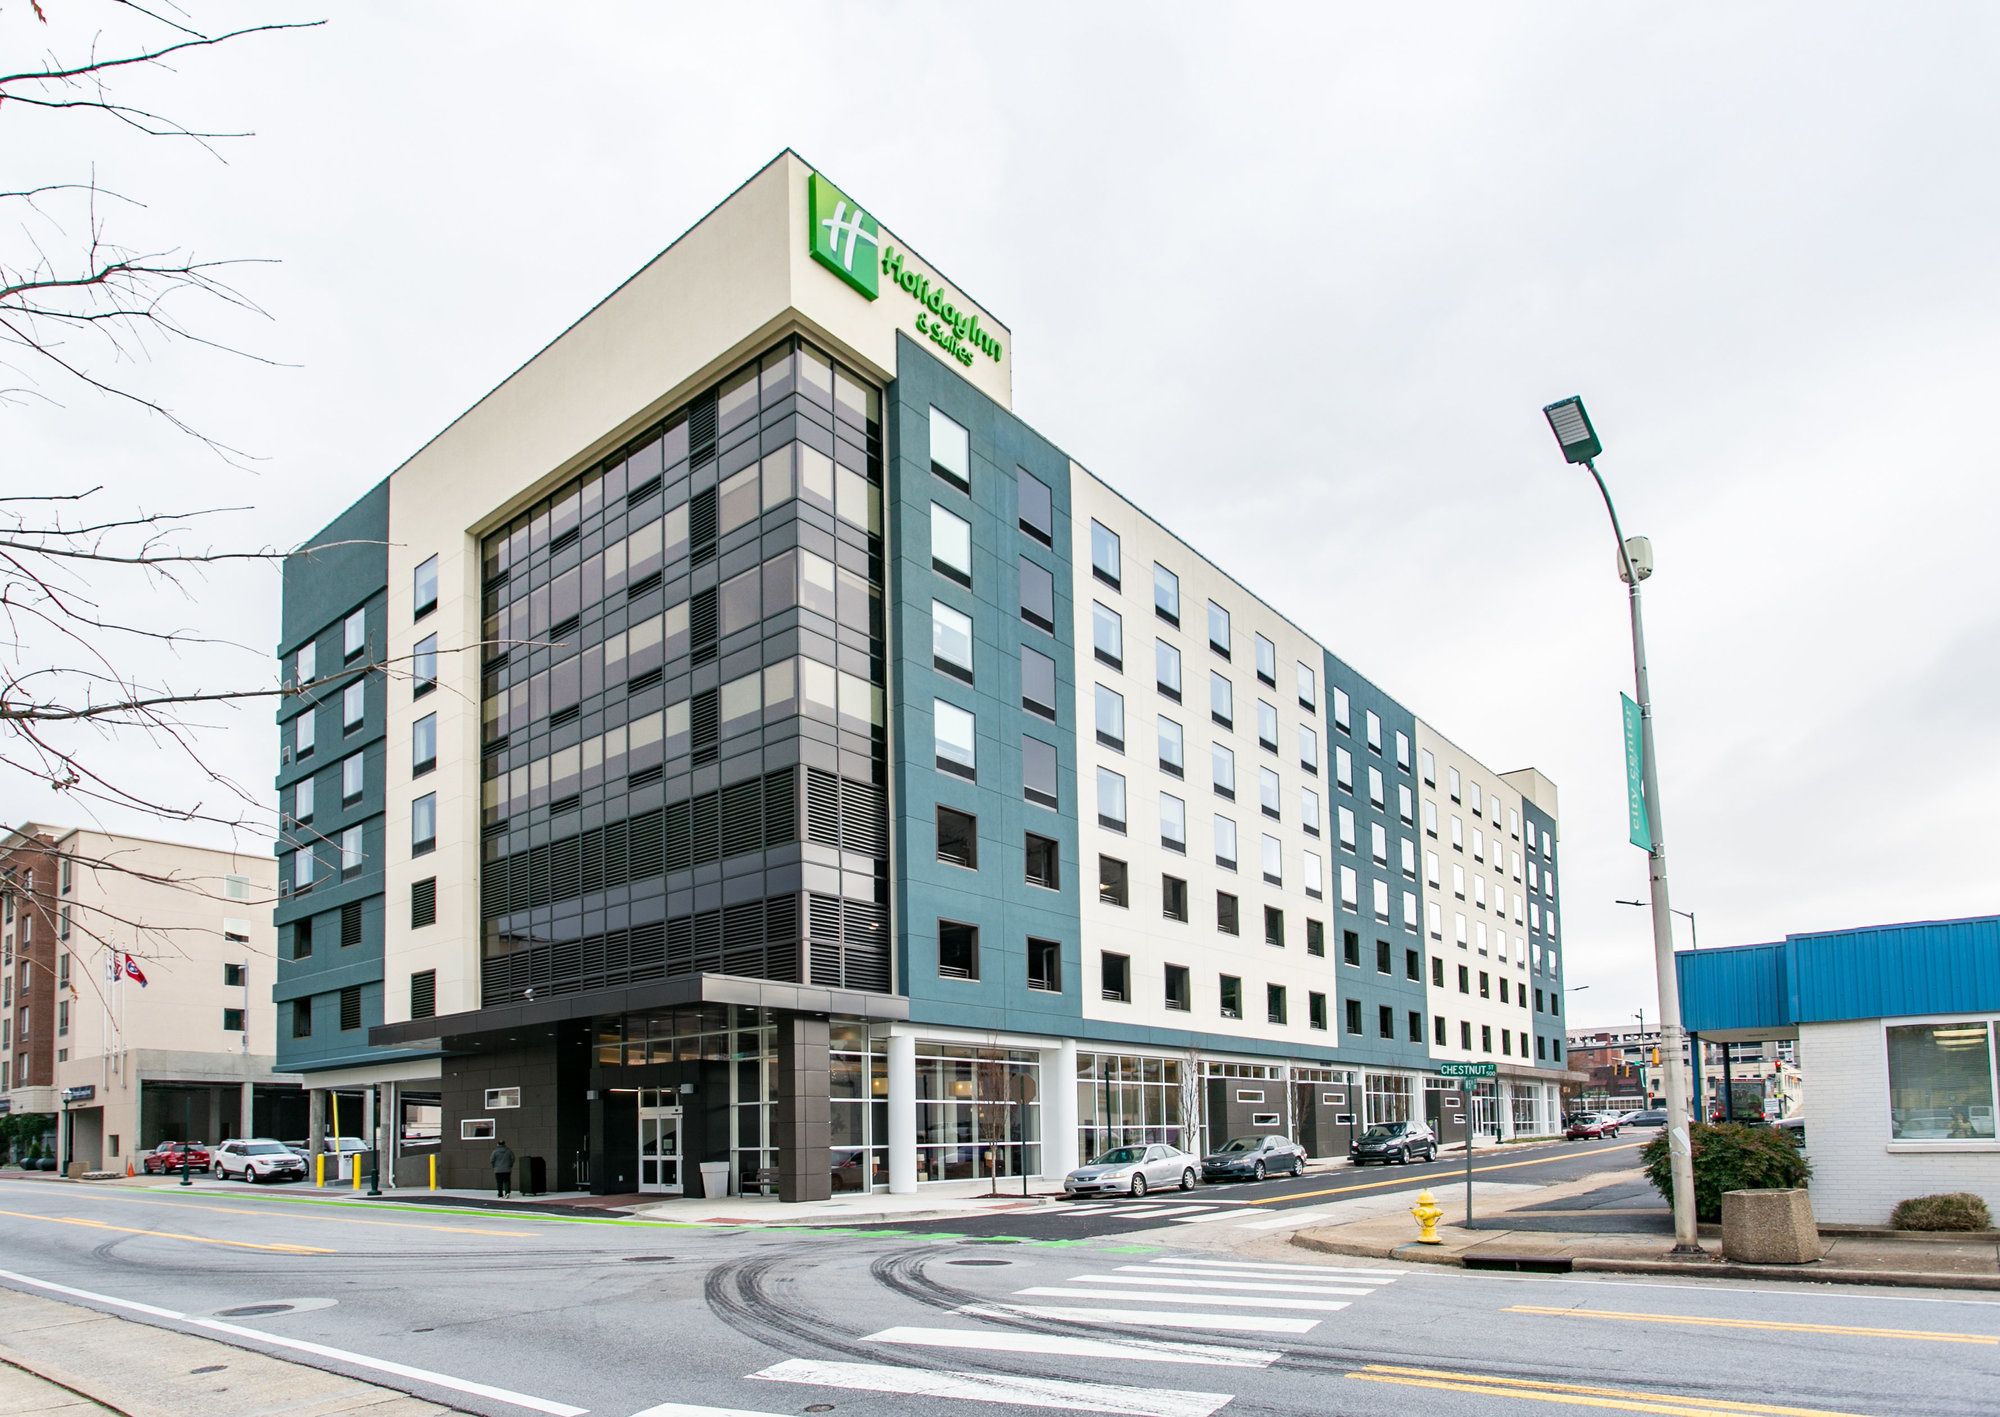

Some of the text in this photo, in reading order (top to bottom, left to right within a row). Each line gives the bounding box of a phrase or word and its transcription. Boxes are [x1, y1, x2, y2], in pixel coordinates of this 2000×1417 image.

[881, 245, 1003, 363] Holiday Inn
[915, 311, 974, 367] & Suites
[1625, 705, 1640, 831] city center
[1441, 1065, 1486, 1075] CHESTNUT
